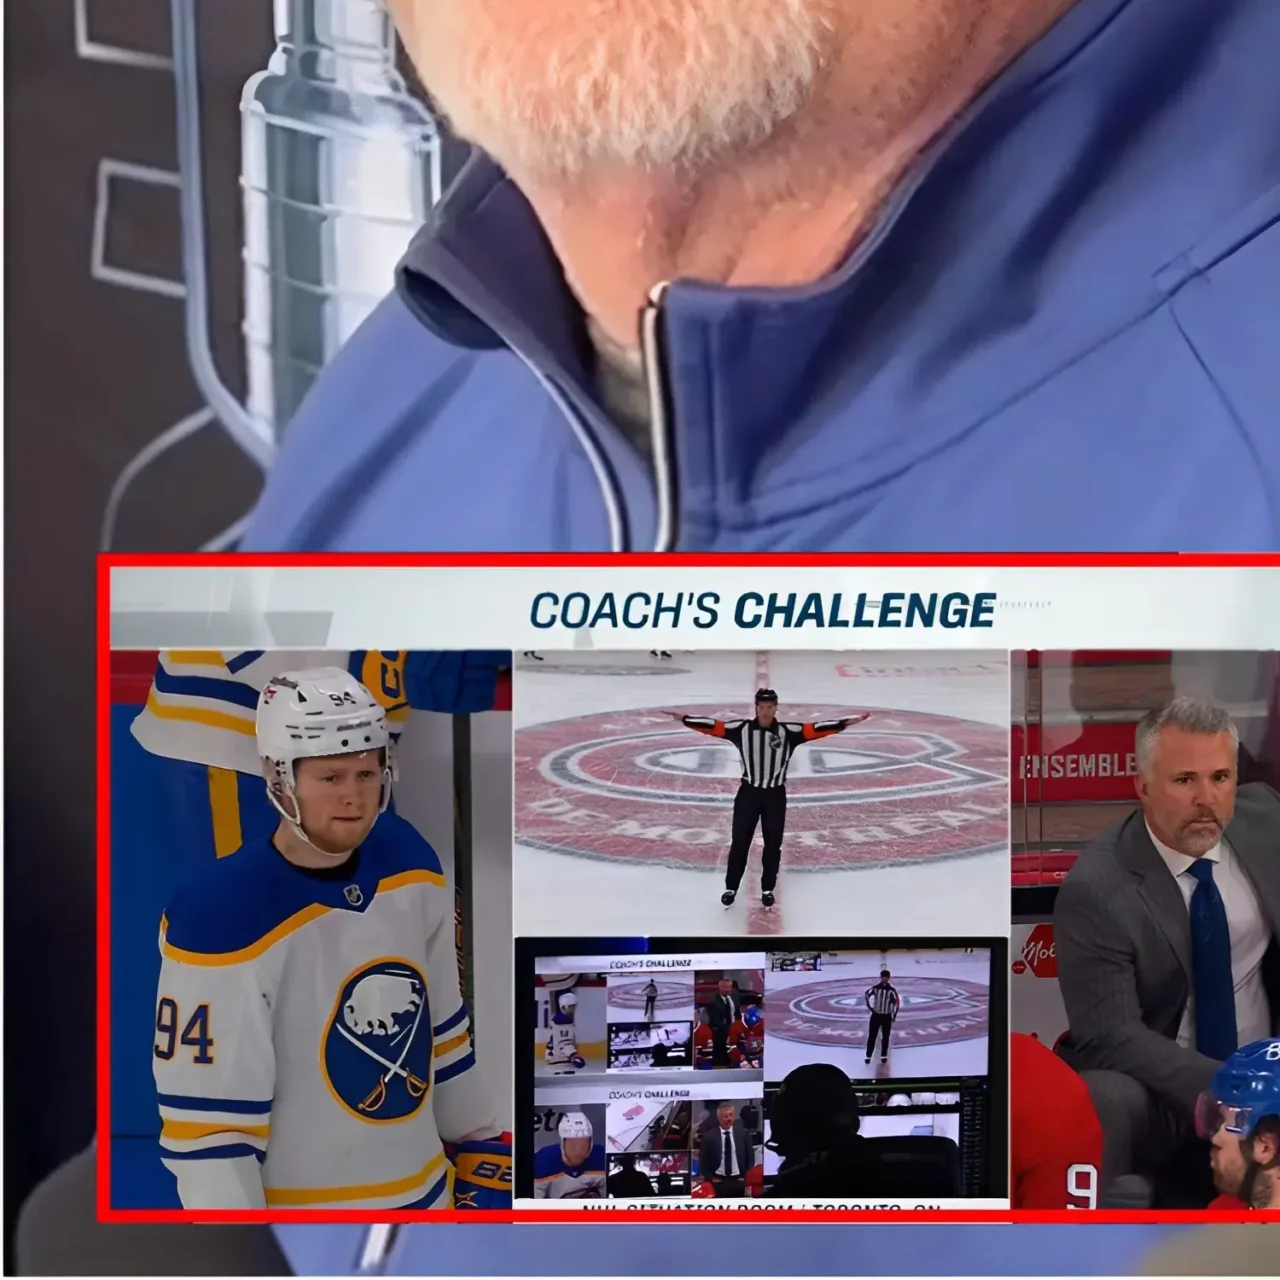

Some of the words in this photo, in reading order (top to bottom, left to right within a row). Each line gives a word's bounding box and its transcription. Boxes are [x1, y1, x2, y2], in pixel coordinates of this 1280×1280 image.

[1019, 752, 1140, 780] ENSEMBLE
[154, 995, 214, 1065] 94
[1066, 1163, 1098, 1210] 9
